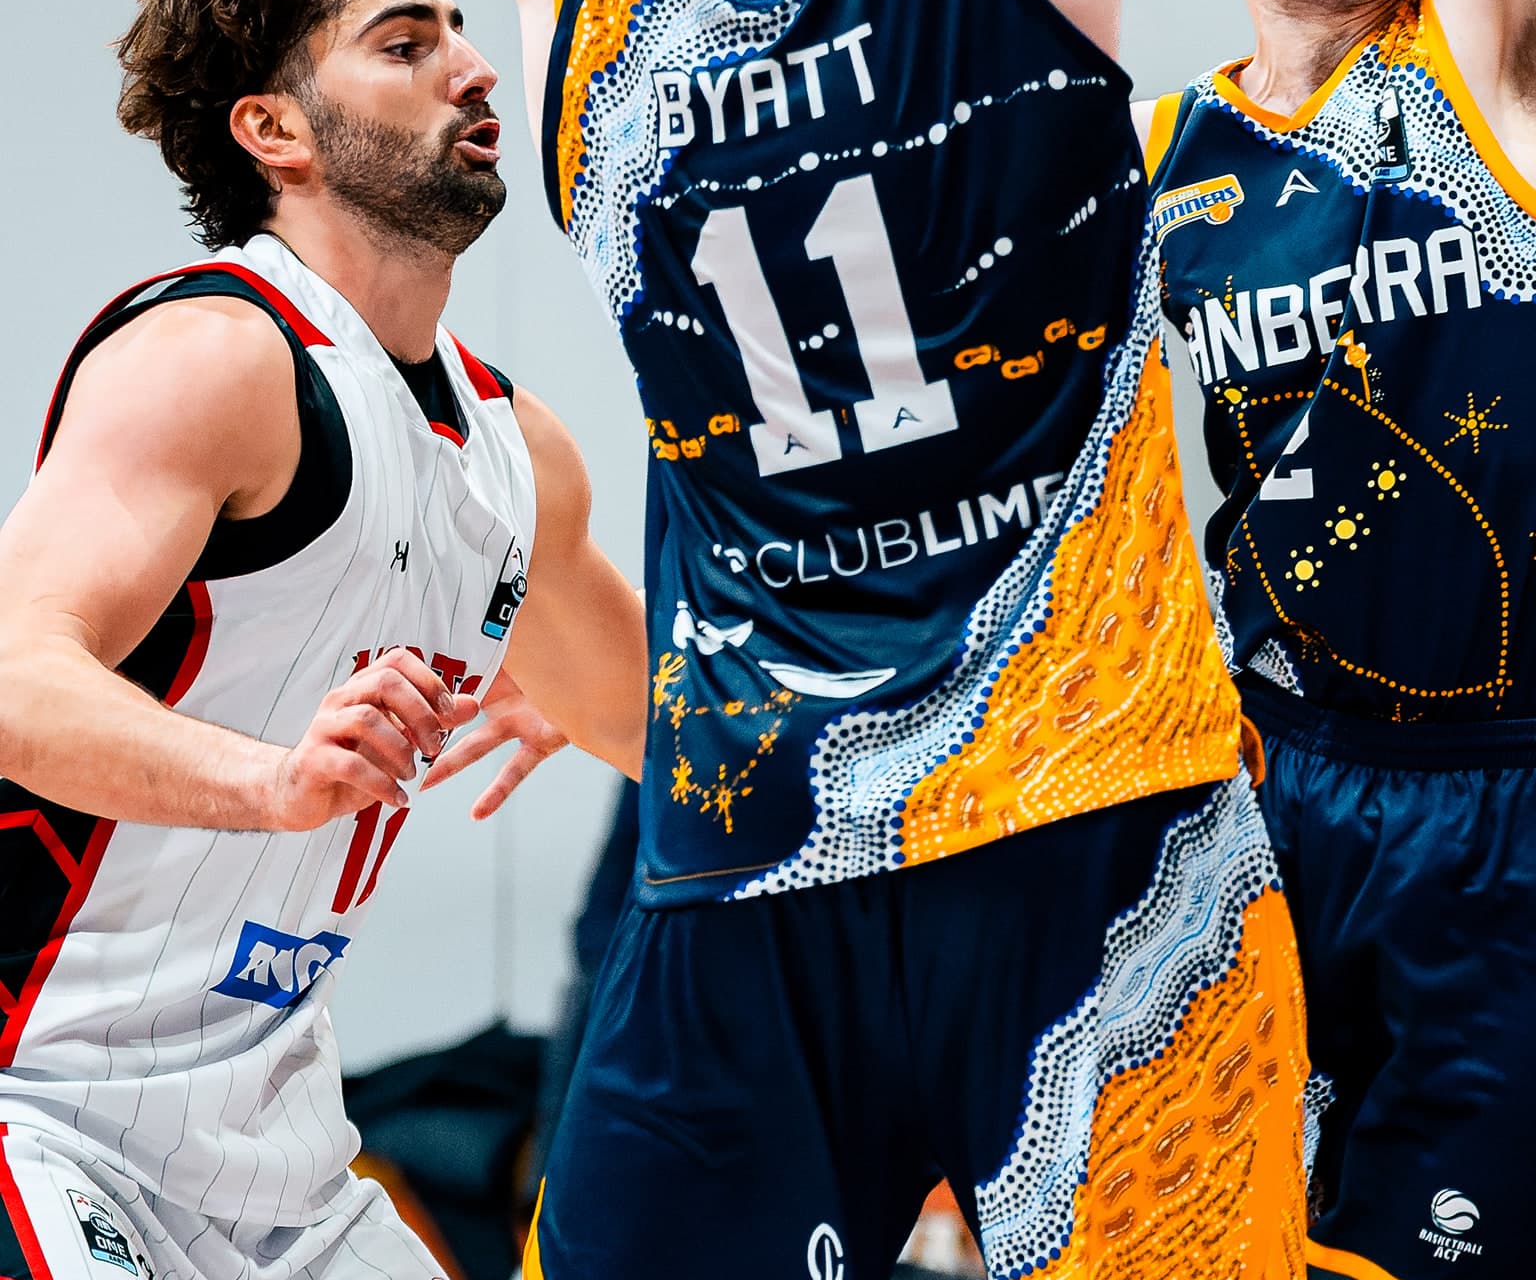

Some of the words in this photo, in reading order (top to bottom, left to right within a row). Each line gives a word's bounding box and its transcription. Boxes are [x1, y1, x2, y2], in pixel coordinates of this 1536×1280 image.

[651, 23, 876, 149] BYATT
[1154, 186, 1238, 231] UNNERS
[691, 173, 959, 477] 11
[1185, 224, 1482, 385] ANBERA
[94, 1235, 128, 1259] ONE
[1418, 1228, 1483, 1255] BASKETBALL
[1433, 1246, 1461, 1262] ACT
